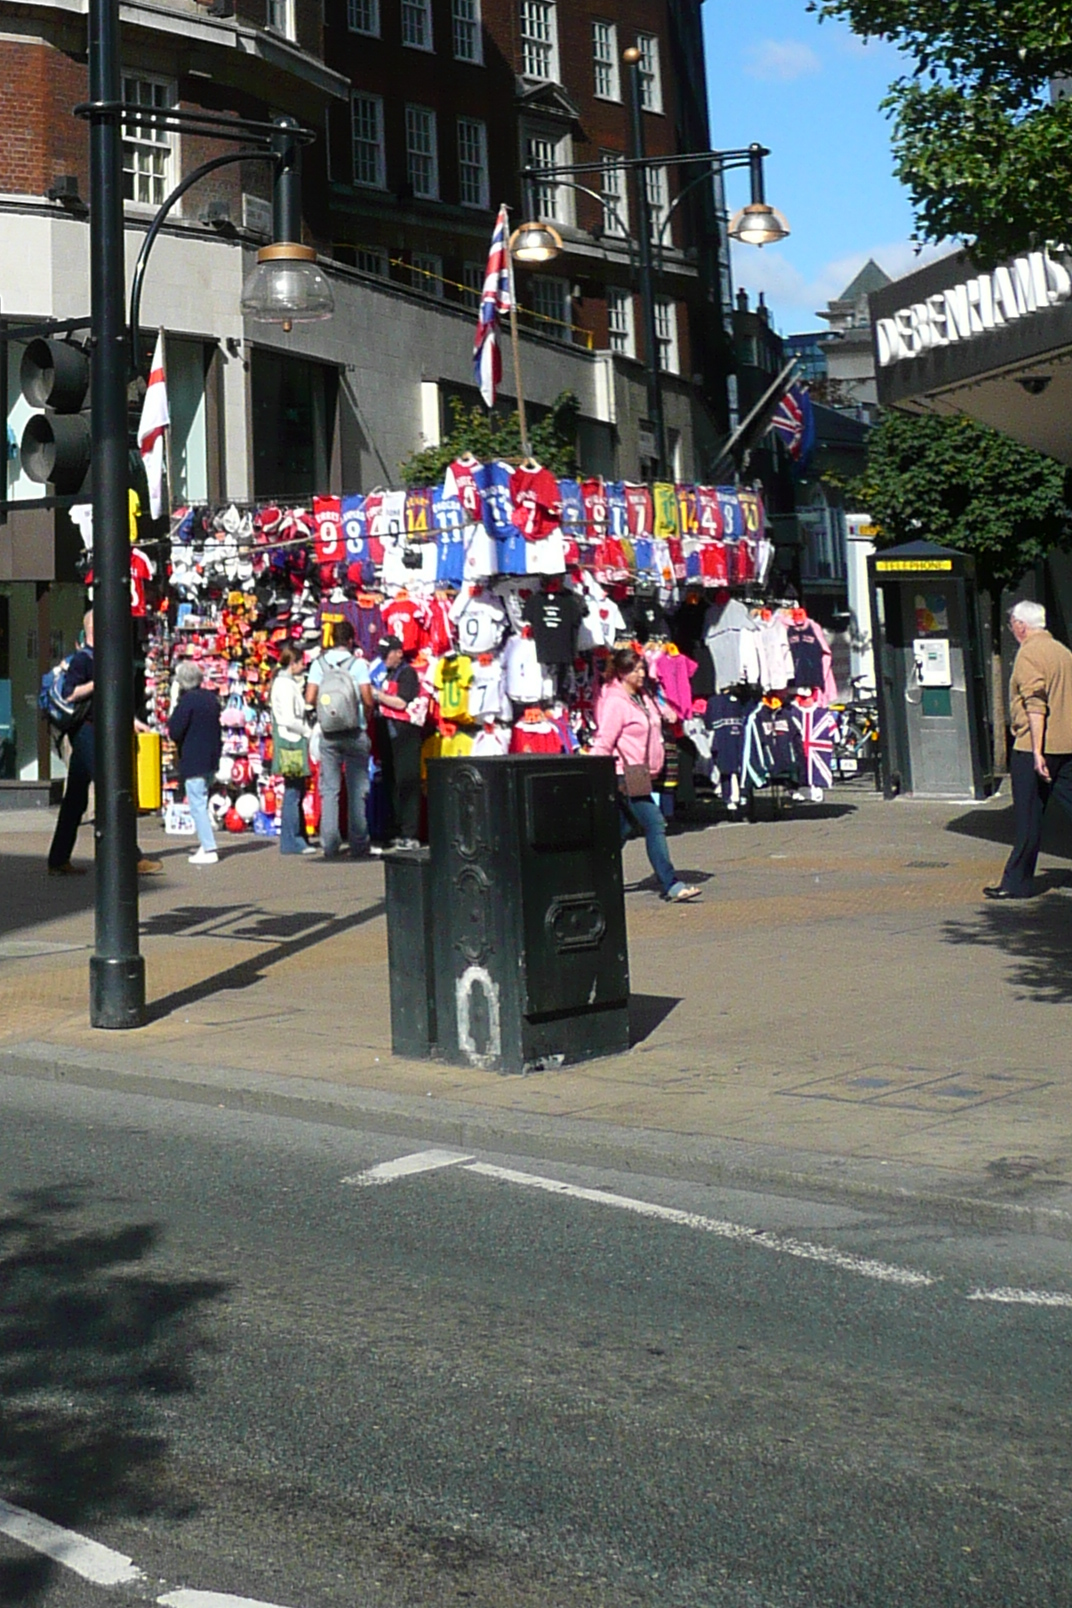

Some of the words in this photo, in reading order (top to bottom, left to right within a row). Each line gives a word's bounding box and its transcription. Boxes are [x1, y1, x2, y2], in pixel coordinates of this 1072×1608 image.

[876, 240, 1071, 367] DEBENHAMS
[345, 520, 365, 554] 8
[405, 507, 429, 539] 14
[701, 506, 718, 536] 4
[319, 521, 338, 555] 9
[466, 618, 479, 647] 9
[477, 685, 489, 712] 7
